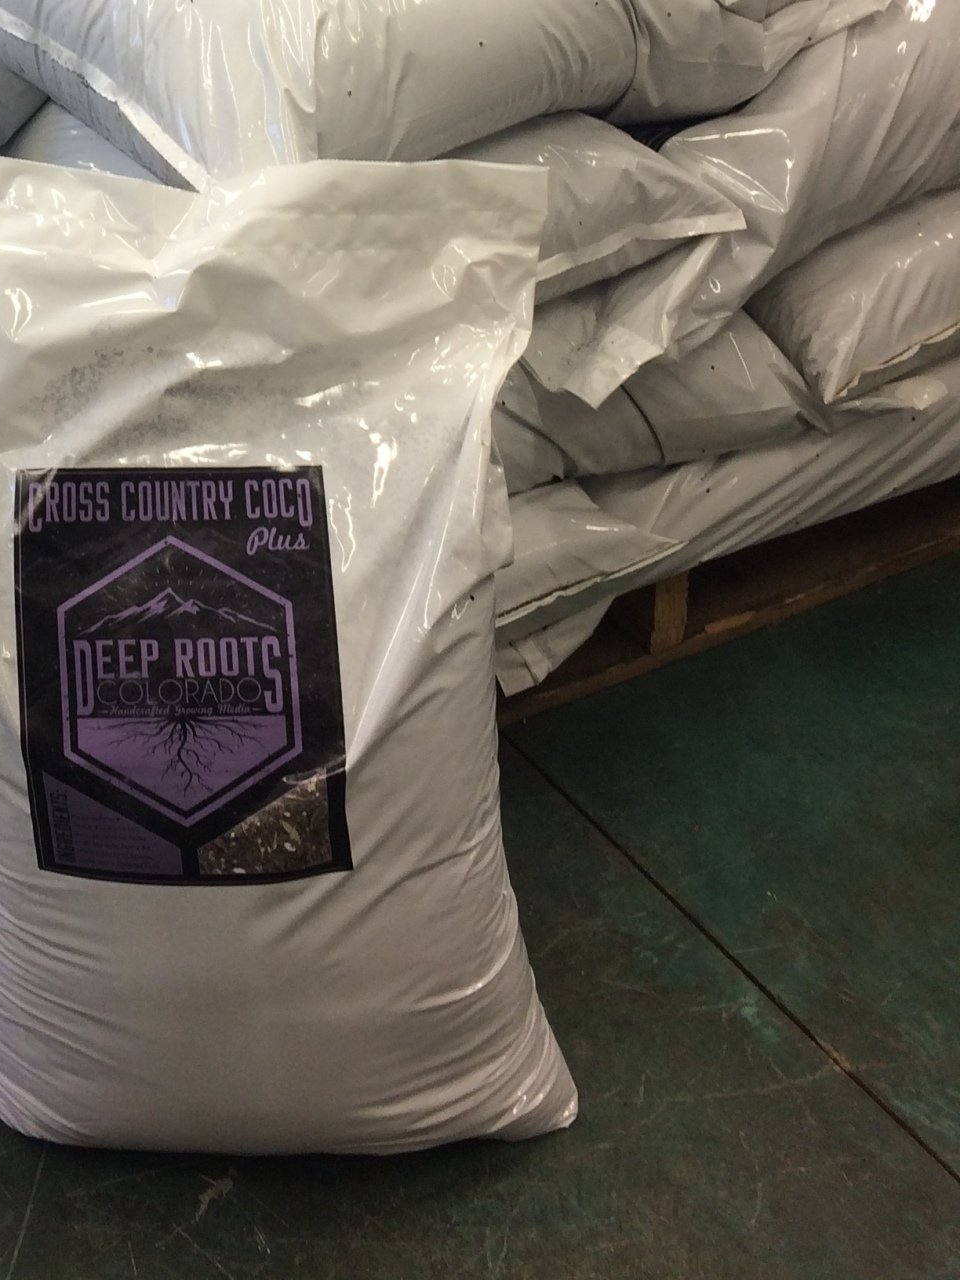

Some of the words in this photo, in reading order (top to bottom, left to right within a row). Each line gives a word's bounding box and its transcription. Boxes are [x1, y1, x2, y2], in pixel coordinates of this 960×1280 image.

[27, 479, 110, 534] CROSS
[120, 478, 235, 522] COUNTRY
[244, 477, 314, 528] COCO
[246, 526, 310, 556] Plus
[72, 638, 160, 717] DEEP
[174, 635, 284, 713] ROOTS
[96, 676, 262, 706] COLORADO
[109, 705, 171, 717] Handcrafted
[174, 705, 213, 717] Growing
[217, 703, 252, 714] Media
